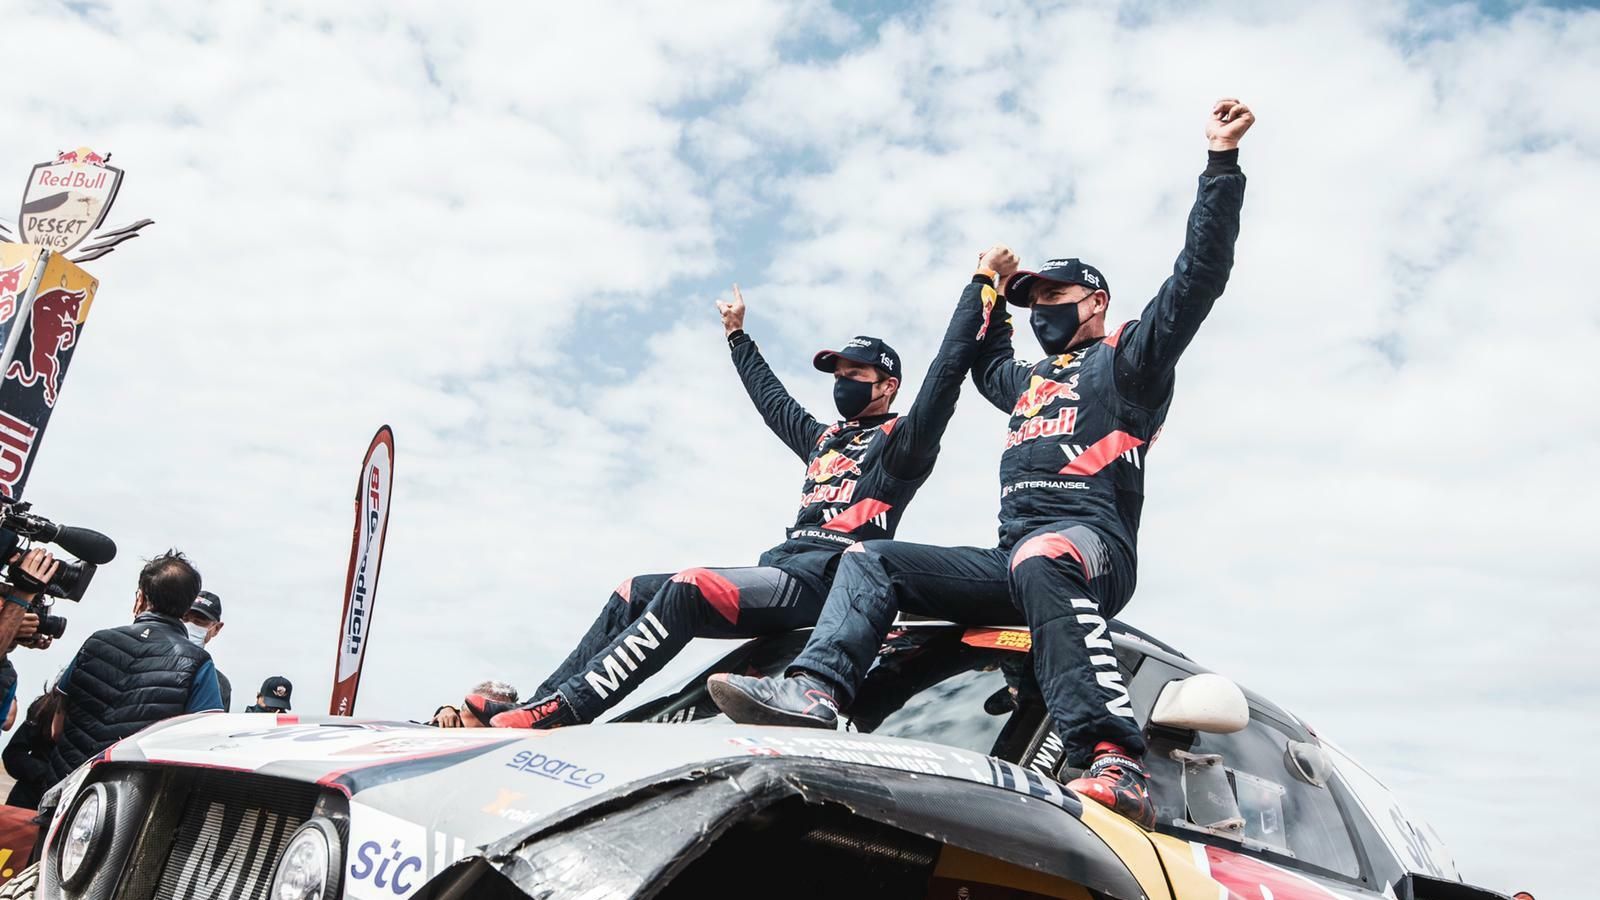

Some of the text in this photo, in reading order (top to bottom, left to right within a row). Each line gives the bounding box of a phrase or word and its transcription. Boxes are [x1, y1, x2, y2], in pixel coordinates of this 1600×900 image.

[27, 217, 87, 235] DESERT
[1081, 269, 1101, 288] 1st
[879, 352, 895, 371] 1st
[1014, 480, 1090, 492] PETERHANSEL
[584, 611, 670, 700] MINI
[1070, 598, 1134, 718] MINI
[506, 750, 606, 789] sparco
